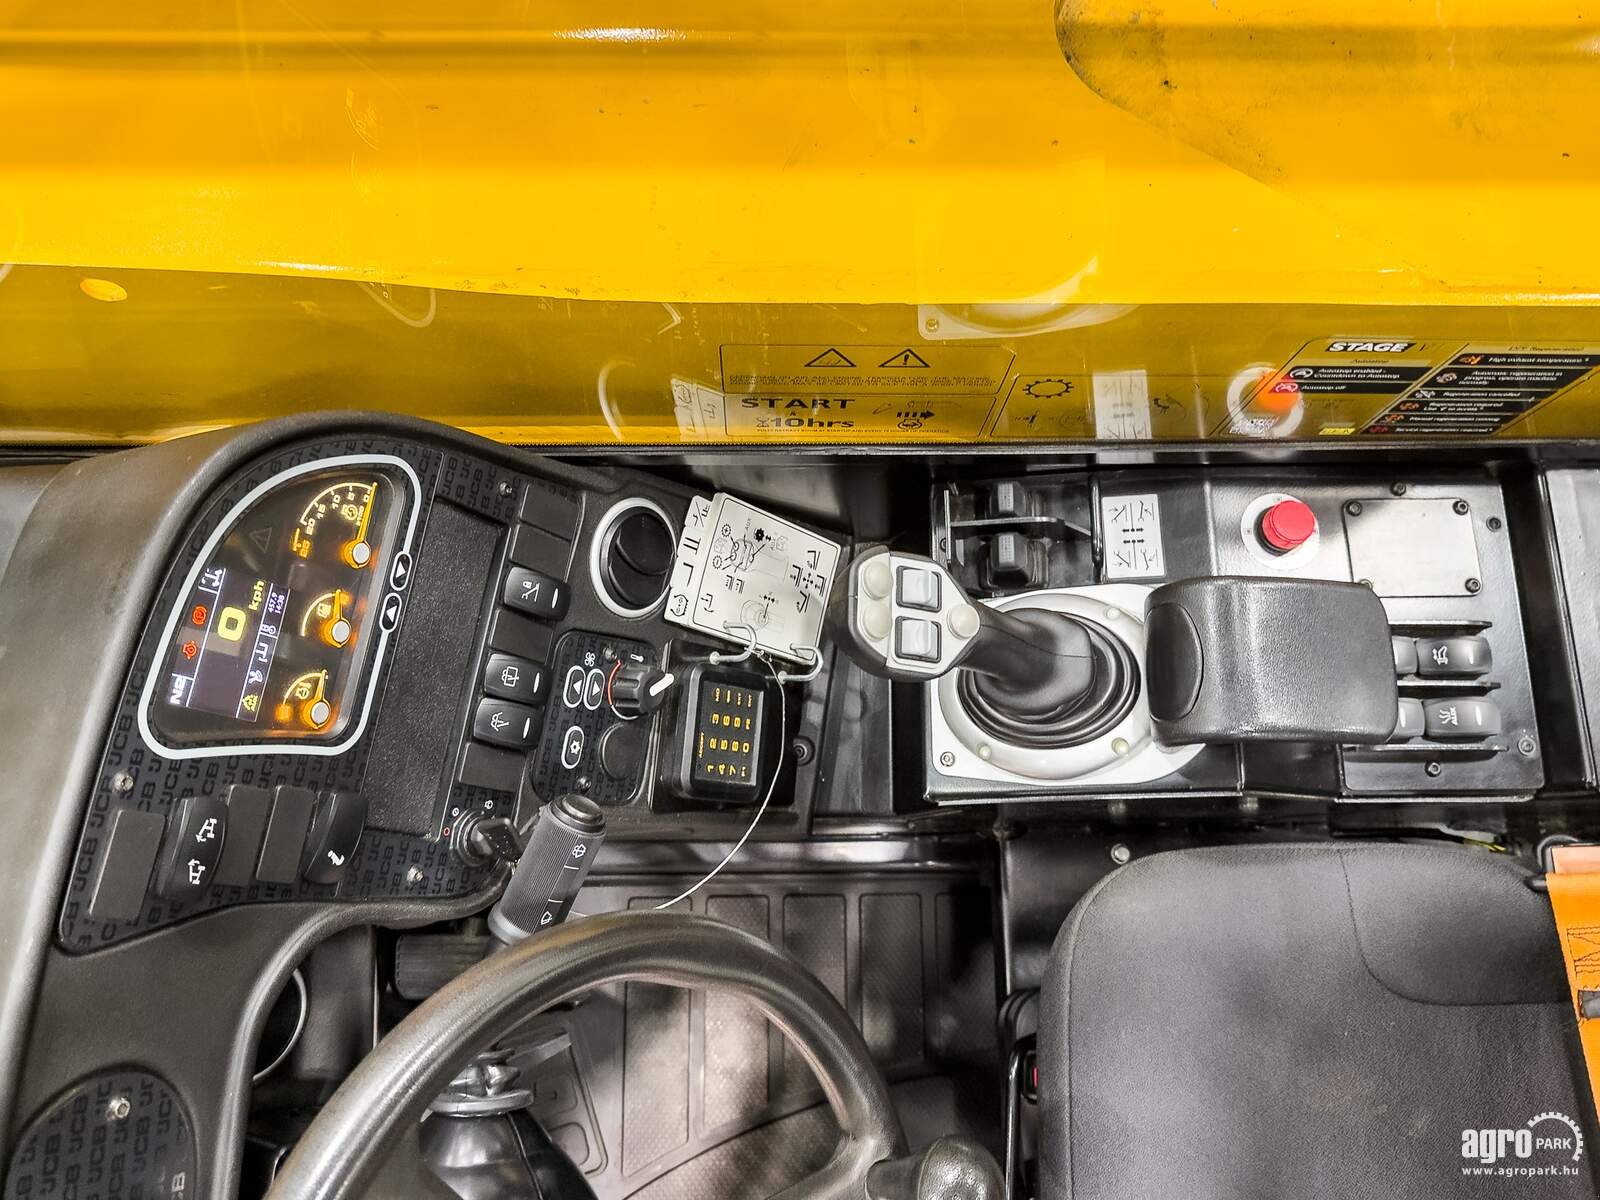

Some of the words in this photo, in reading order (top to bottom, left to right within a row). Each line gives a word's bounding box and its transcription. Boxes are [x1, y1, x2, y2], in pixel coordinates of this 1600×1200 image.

[1329, 342, 1409, 353] STAGE
[741, 398, 856, 410] START
[769, 417, 856, 429] 10hrs
[442, 457, 458, 496] JCB
[468, 468, 484, 507] JCB
[248, 579, 266, 611] kph
[217, 606, 247, 642] 0
[109, 714, 134, 767] JCB
[73, 837, 99, 892] JCB
[376, 845, 395, 889] JCB
[432, 851, 449, 895] JCB
[69, 1094, 88, 1154] JCB
[131, 1116, 150, 1175] JCB
[40, 1134, 61, 1195] JCB
[87, 1125, 107, 1184] JCB
